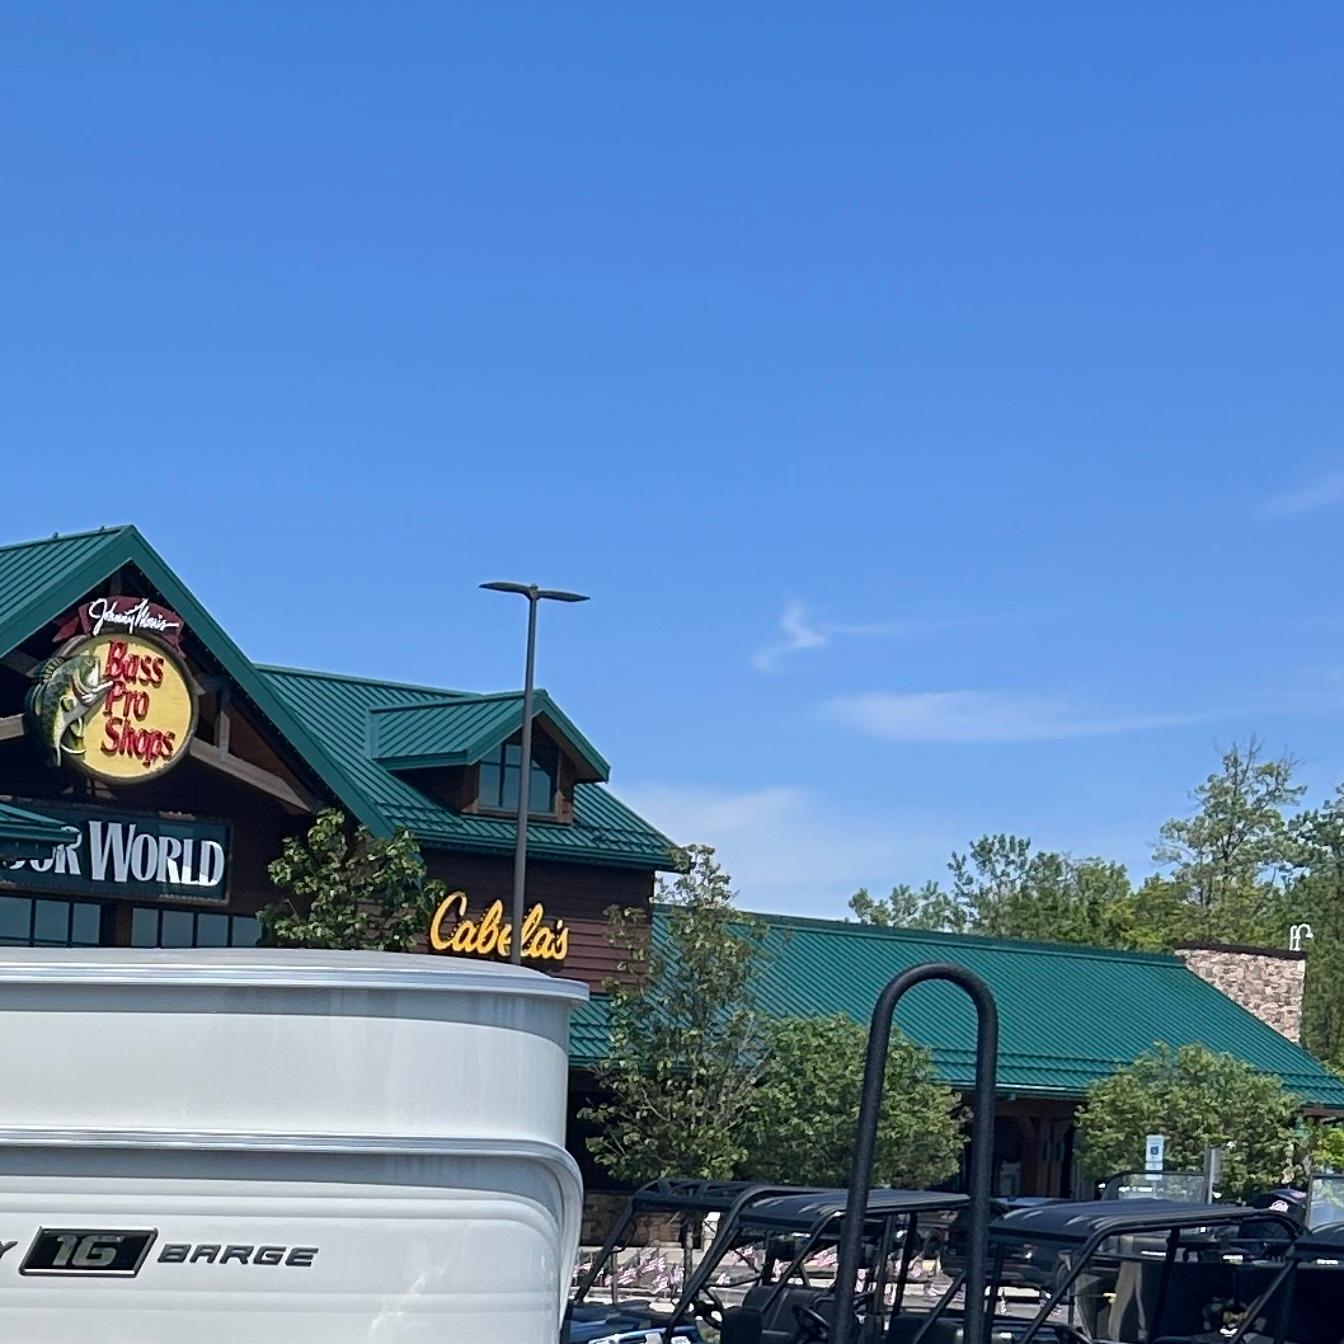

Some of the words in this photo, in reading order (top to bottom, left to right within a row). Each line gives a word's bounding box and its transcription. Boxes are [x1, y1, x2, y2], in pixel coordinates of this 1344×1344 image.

[102, 640, 165, 688] Bass
[103, 681, 150, 722] Pro
[100, 717, 176, 768] Shops
[88, 820, 225, 887] WORLD
[430, 891, 569, 961] Cabela's
[53, 1234, 121, 1267] 16
[156, 1243, 320, 1267] BARGE
